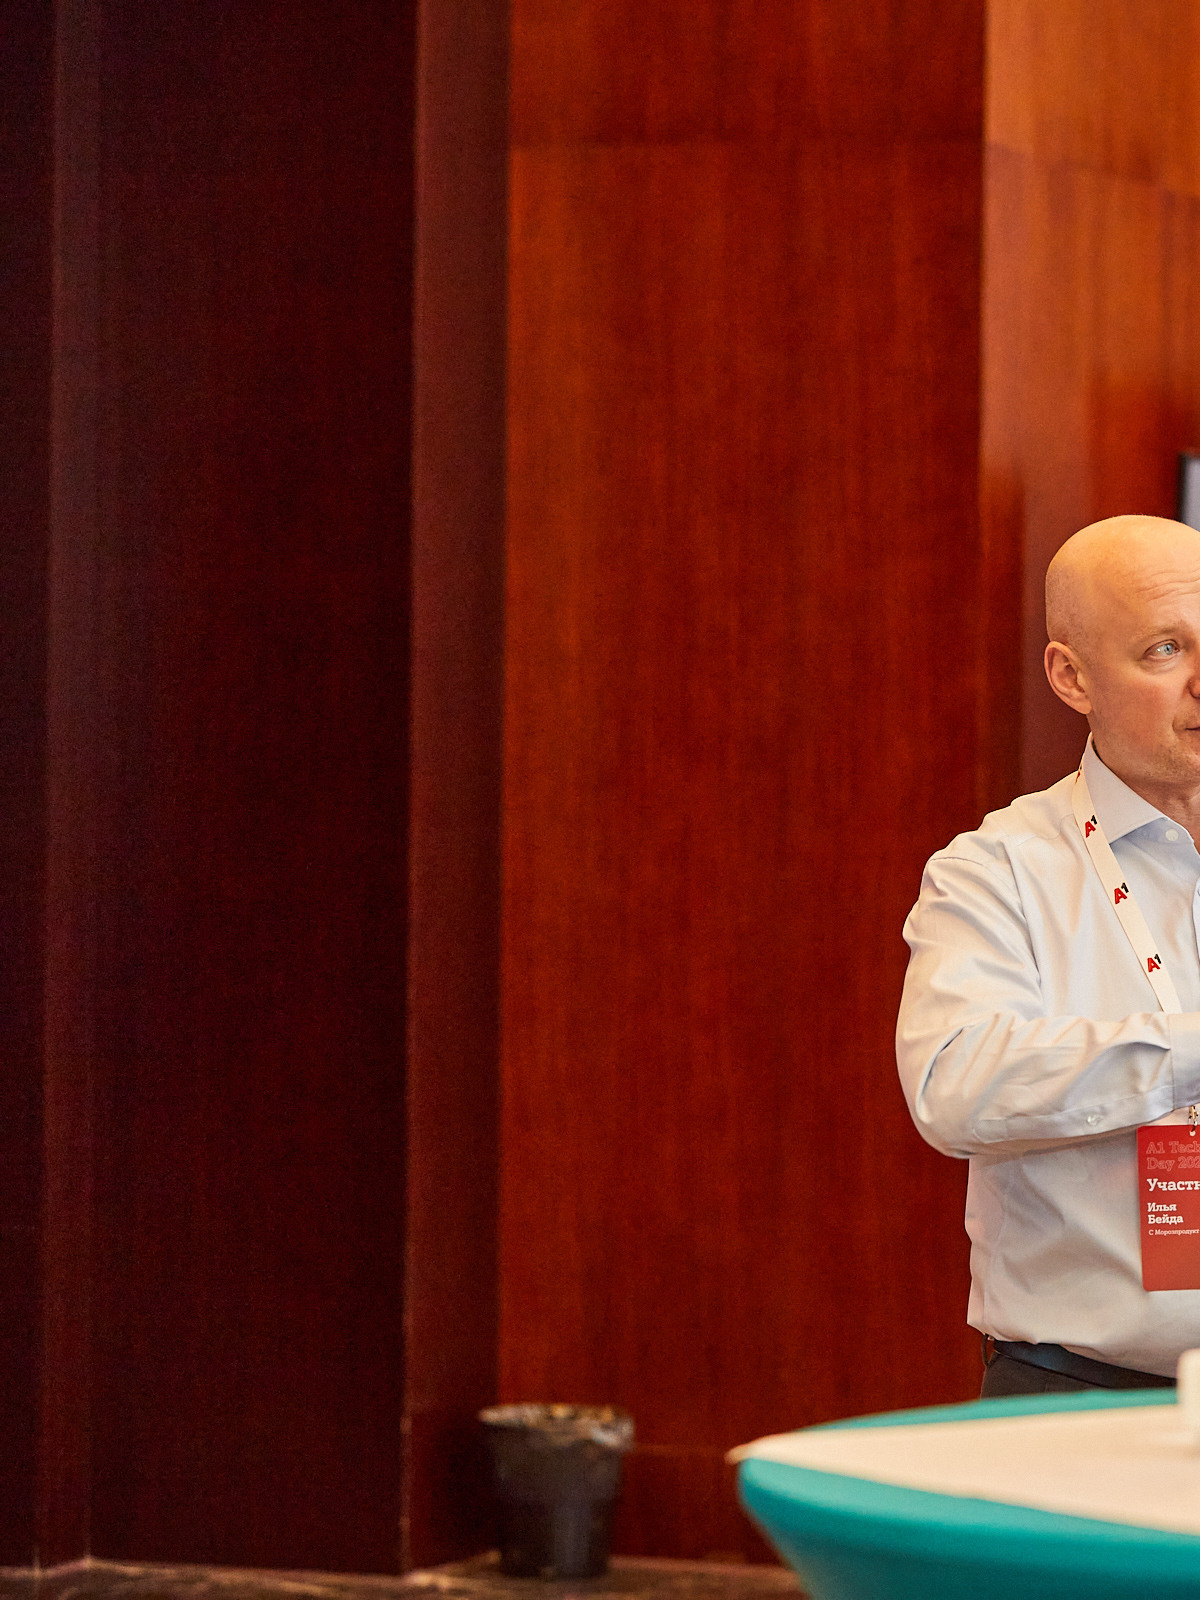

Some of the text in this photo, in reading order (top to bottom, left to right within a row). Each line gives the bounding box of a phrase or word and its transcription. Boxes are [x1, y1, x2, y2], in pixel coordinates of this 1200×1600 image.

[1084, 815, 1097, 838] A1
[1113, 882, 1129, 904] A1
[1147, 954, 1161, 972] A1
[1146, 1142, 1165, 1154] A1
[1146, 1157, 1175, 1171] Day
[1147, 1202, 1177, 1212] Илья
[1147, 1214, 1184, 1225] Бейда
